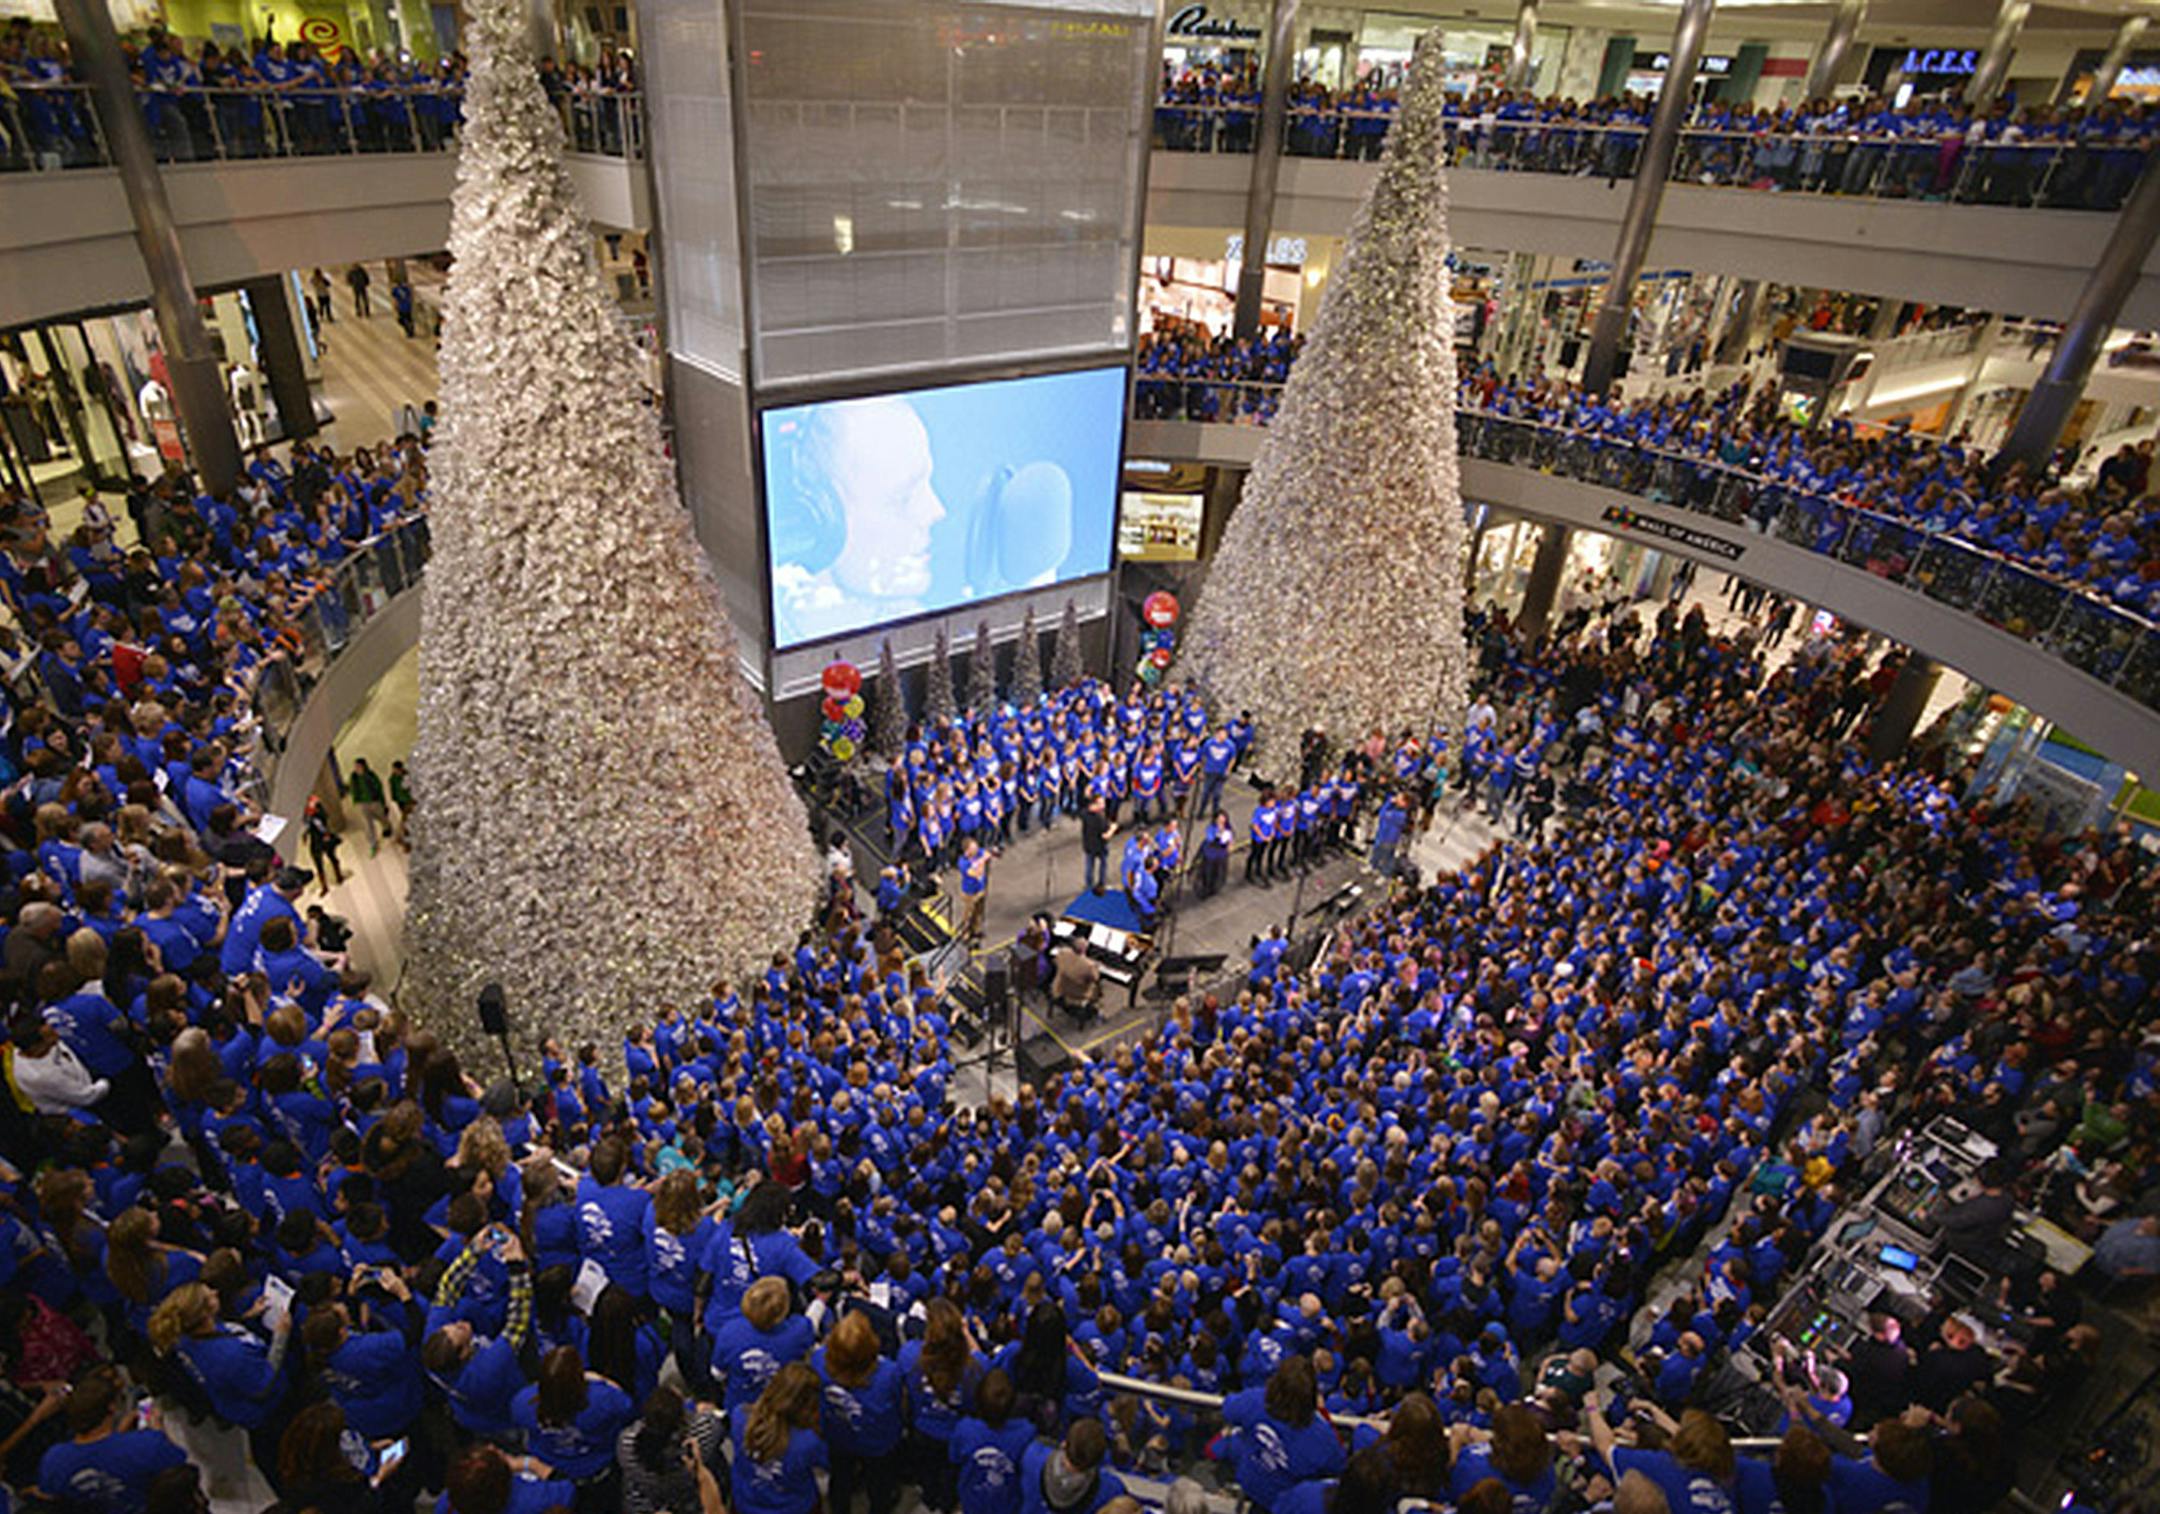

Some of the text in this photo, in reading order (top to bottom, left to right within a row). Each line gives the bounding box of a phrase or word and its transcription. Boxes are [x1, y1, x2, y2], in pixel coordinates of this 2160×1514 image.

[1638, 519, 1736, 556] MALL OF AMERICA
